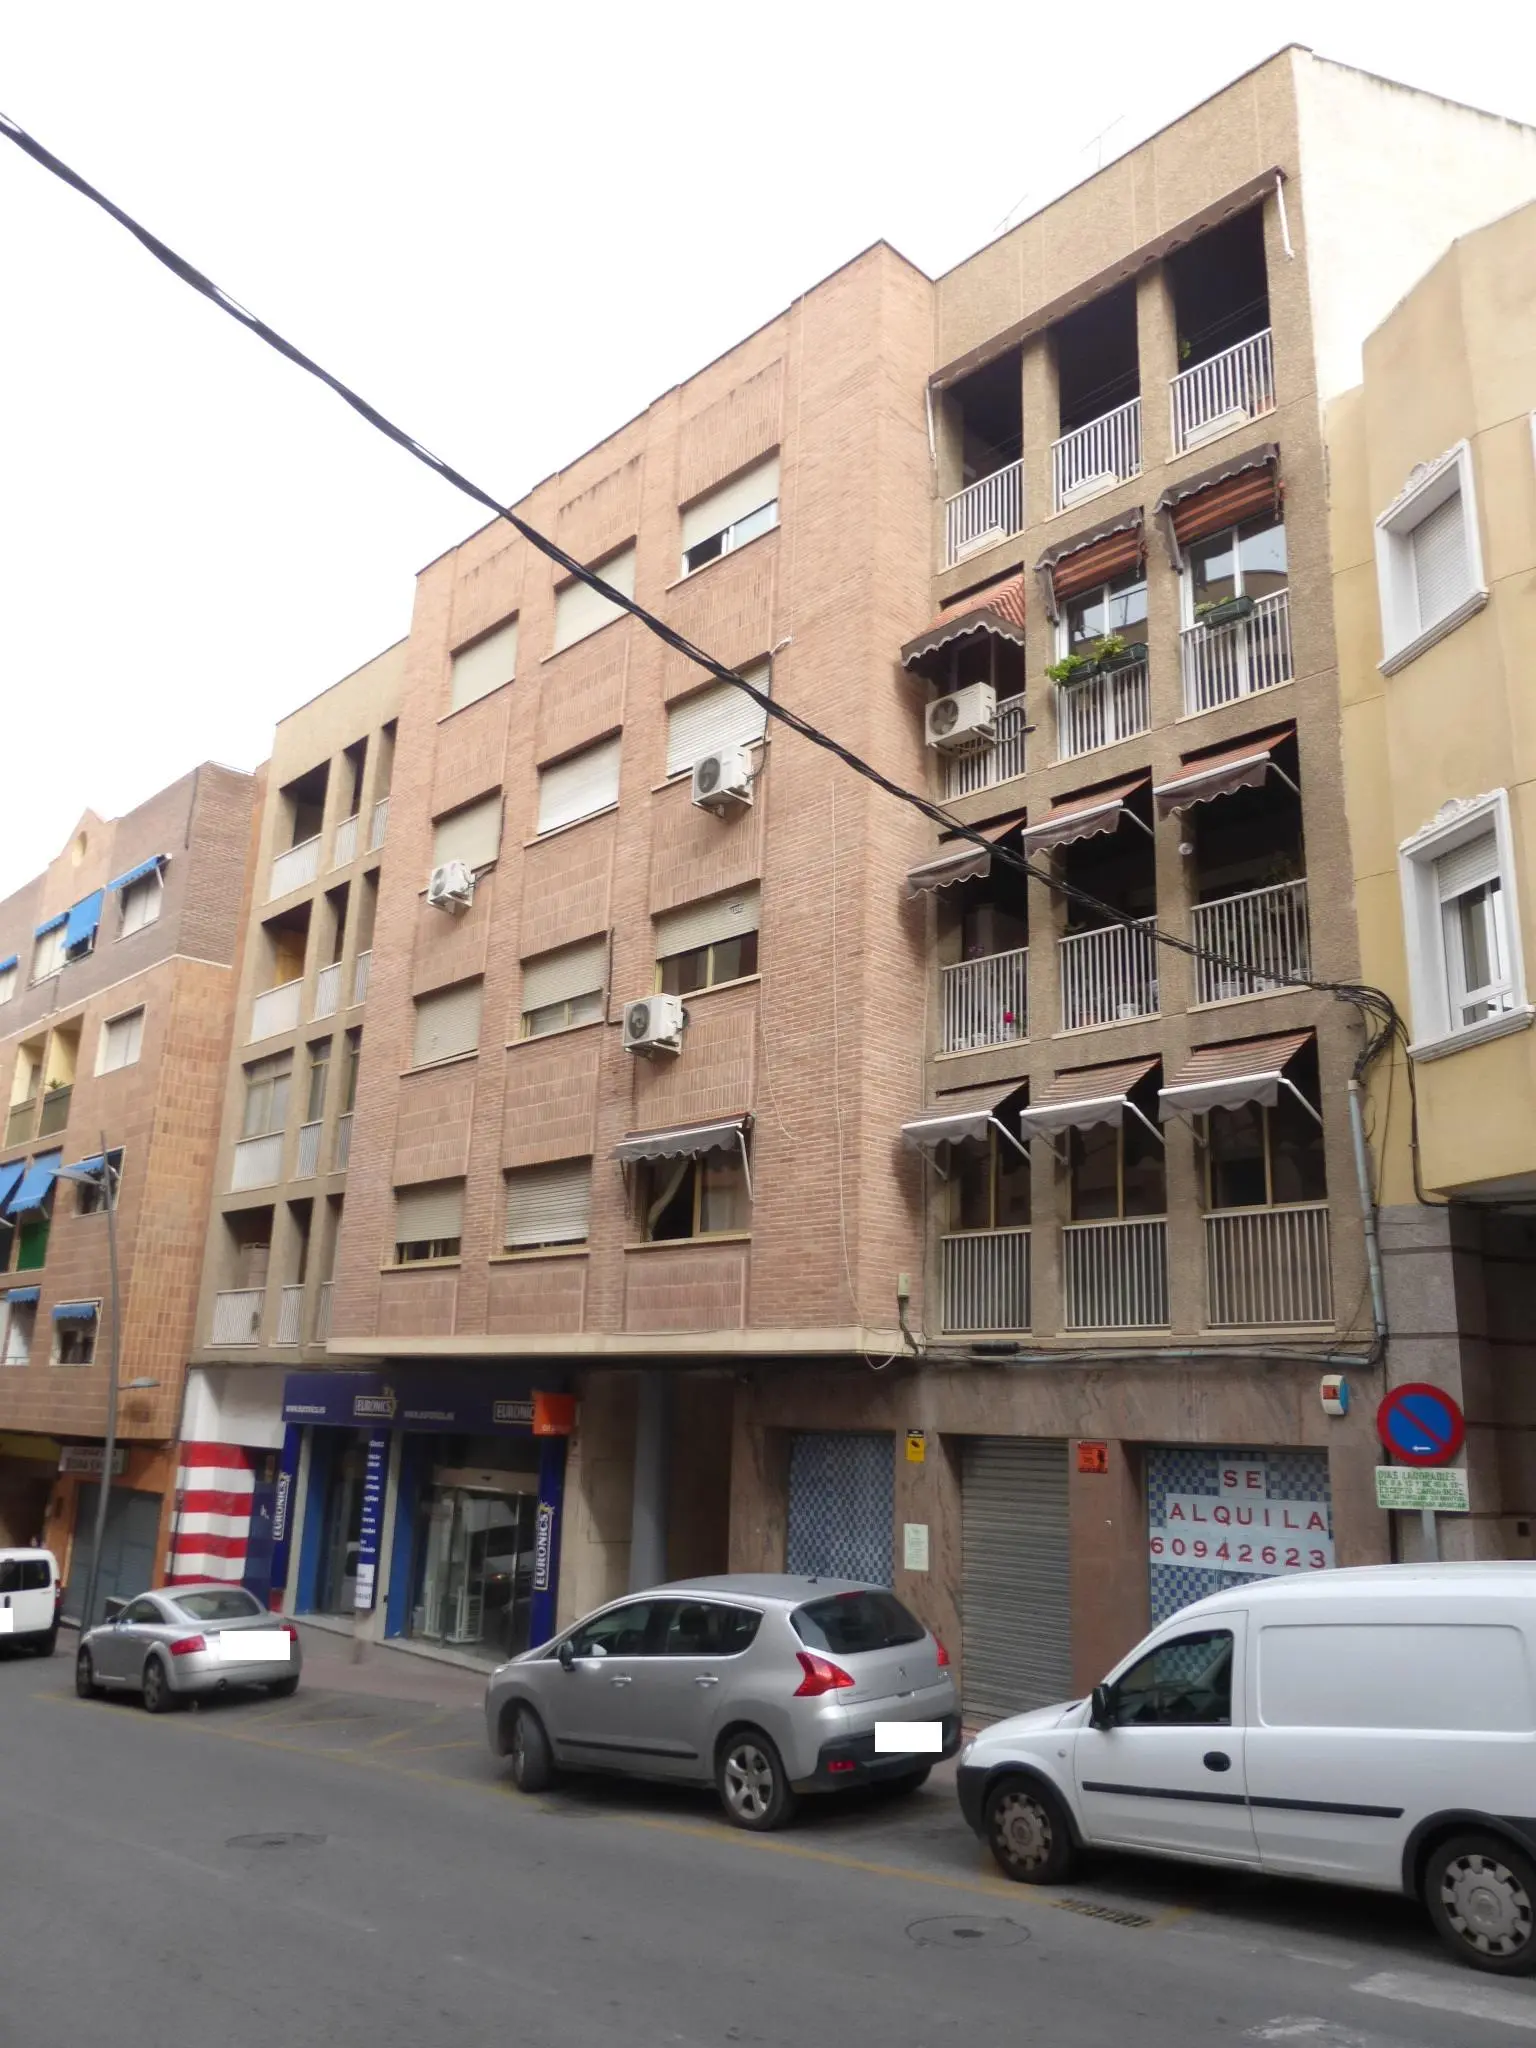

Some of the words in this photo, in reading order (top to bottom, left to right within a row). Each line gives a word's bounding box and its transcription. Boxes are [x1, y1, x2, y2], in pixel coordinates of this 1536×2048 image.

[356, 1399, 392, 1414] EURONICS
[496, 1403, 537, 1420] EURONIC
[1223, 1469, 1262, 1489] SE
[273, 1480, 287, 1538] EURONICS
[1169, 1502, 1326, 1531] ALQUILA
[537, 1513, 549, 1586] EURONICS
[1150, 1536, 1326, 1568] 60942623
